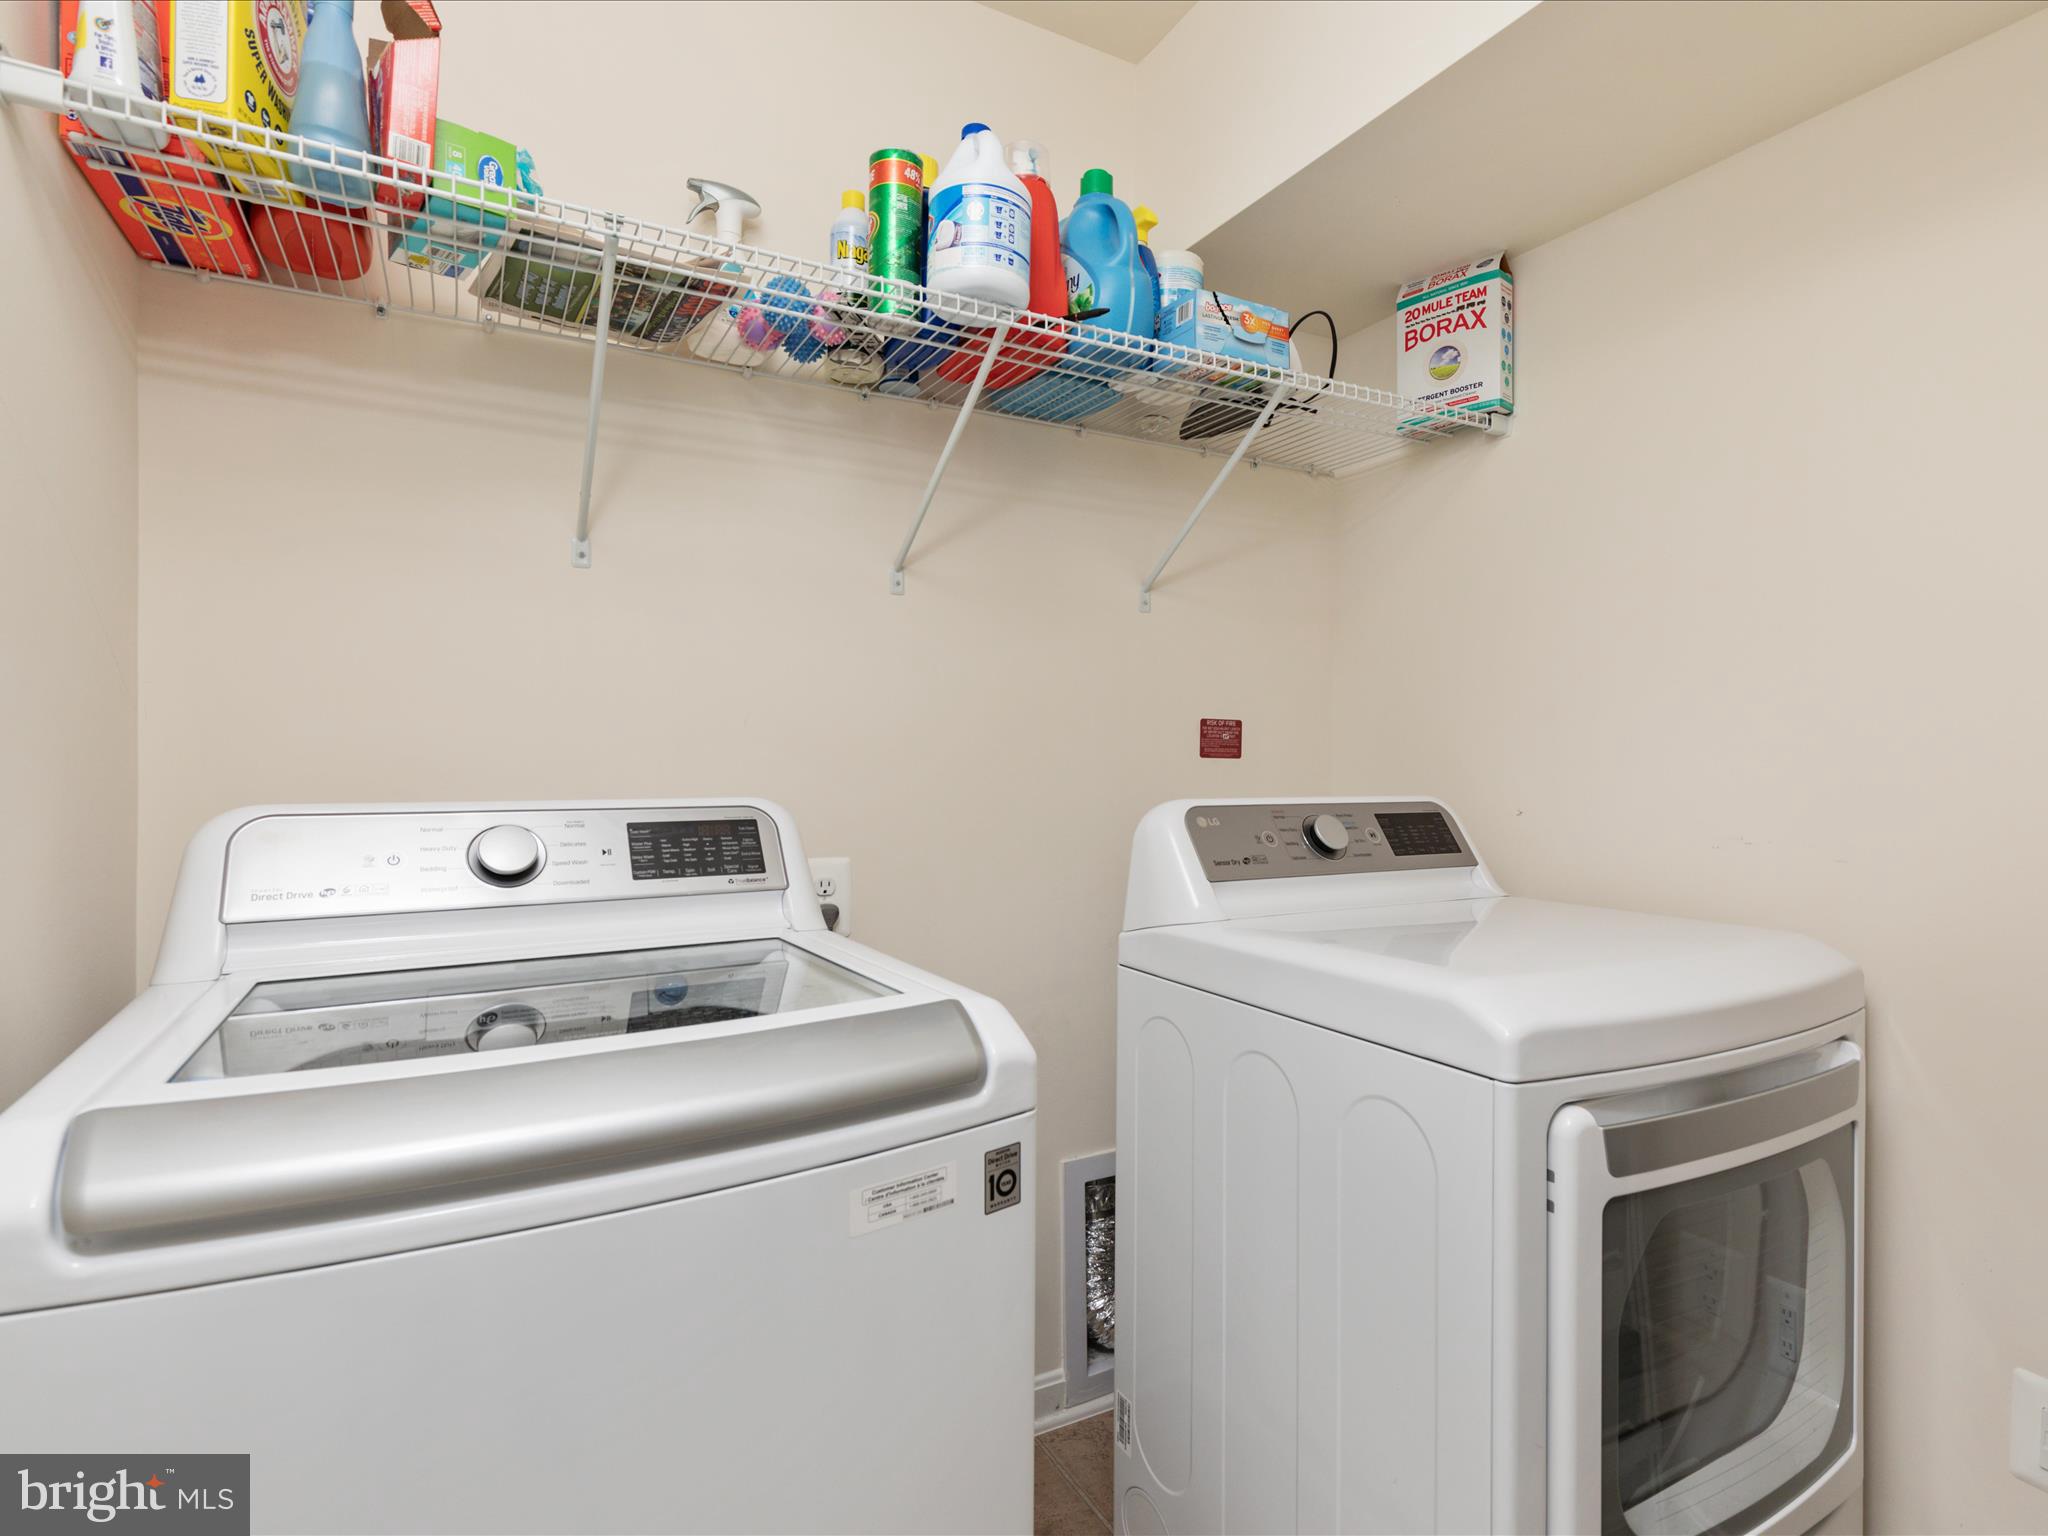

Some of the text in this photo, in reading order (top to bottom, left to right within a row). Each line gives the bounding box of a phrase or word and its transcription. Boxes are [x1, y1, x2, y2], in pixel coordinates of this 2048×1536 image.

[244, 28, 268, 85] SUPER
[1405, 285, 1487, 324] 20 MULE TEAM
[1405, 307, 1487, 352] BORAX
[1450, 381, 1484, 395] BOOSTER
[1208, 817, 1220, 826] LG
[251, 890, 314, 902] Direct Drive
[988, 1155, 1003, 1165] Direct
[1004, 1151, 1018, 1160] Drive
[871, 1184, 895, 1196] Customer
[896, 1177, 923, 1188] Information
[989, 1169, 1017, 1202] 10
